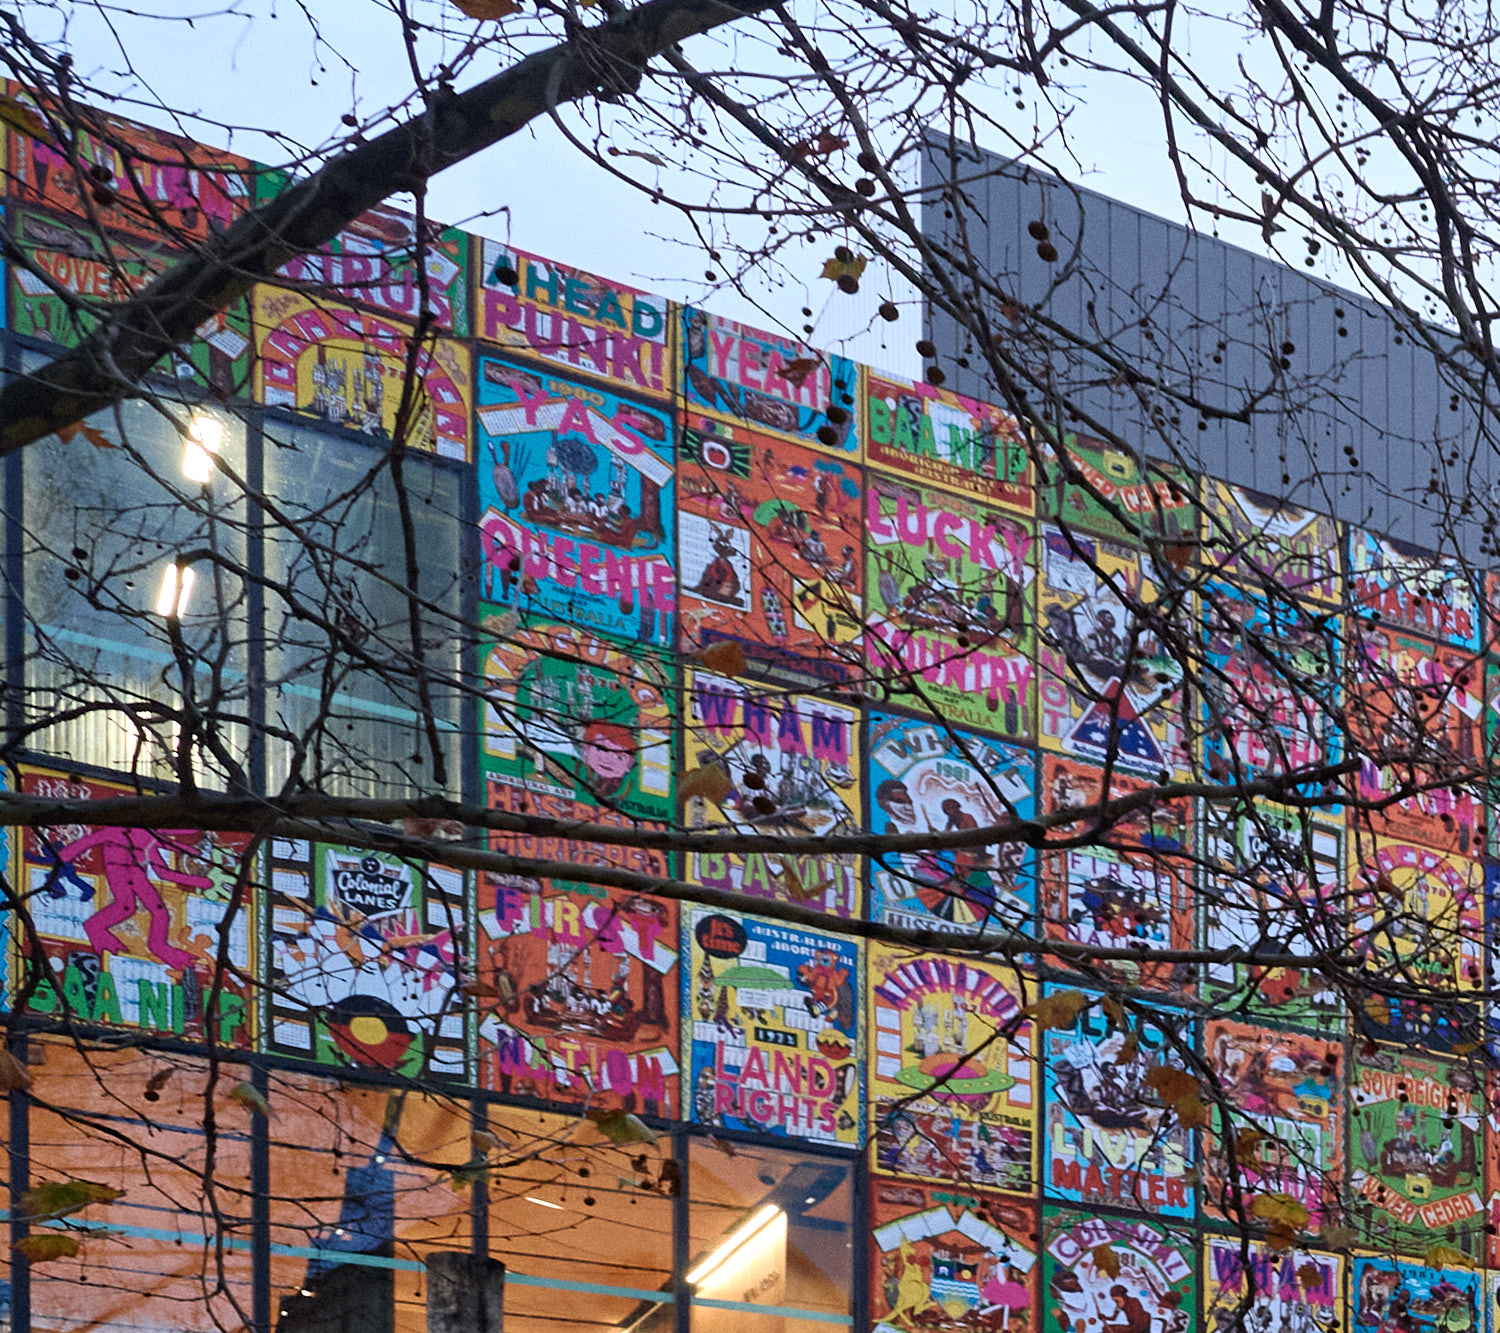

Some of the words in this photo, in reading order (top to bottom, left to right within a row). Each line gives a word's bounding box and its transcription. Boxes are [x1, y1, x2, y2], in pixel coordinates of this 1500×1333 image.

[484, 252, 664, 338] AHEAD
[483, 289, 667, 391] PUNK!
[508, 380, 646, 455] YAS
[549, 380, 605, 405] 1980
[866, 488, 1032, 577] LUCKY
[480, 517, 677, 612] QUEENIE
[1356, 576, 1474, 641] MATTER
[864, 620, 1036, 707] COUNTRY
[697, 682, 849, 762] WHAM
[554, 785, 574, 798] ART
[337, 873, 400, 900] Colonial
[344, 891, 397, 910] LANES
[497, 1029, 664, 1100] NATION
[714, 1039, 838, 1100] LAND
[1361, 1068, 1473, 1116] SOVEREIGNTY
[714, 1081, 838, 1133] RIGHTS
[1053, 1121, 1186, 1176] LIVES
[1052, 1158, 1188, 1209] MATTER
[1360, 1175, 1419, 1225] NEVER
[1421, 1196, 1477, 1229] CEDED
